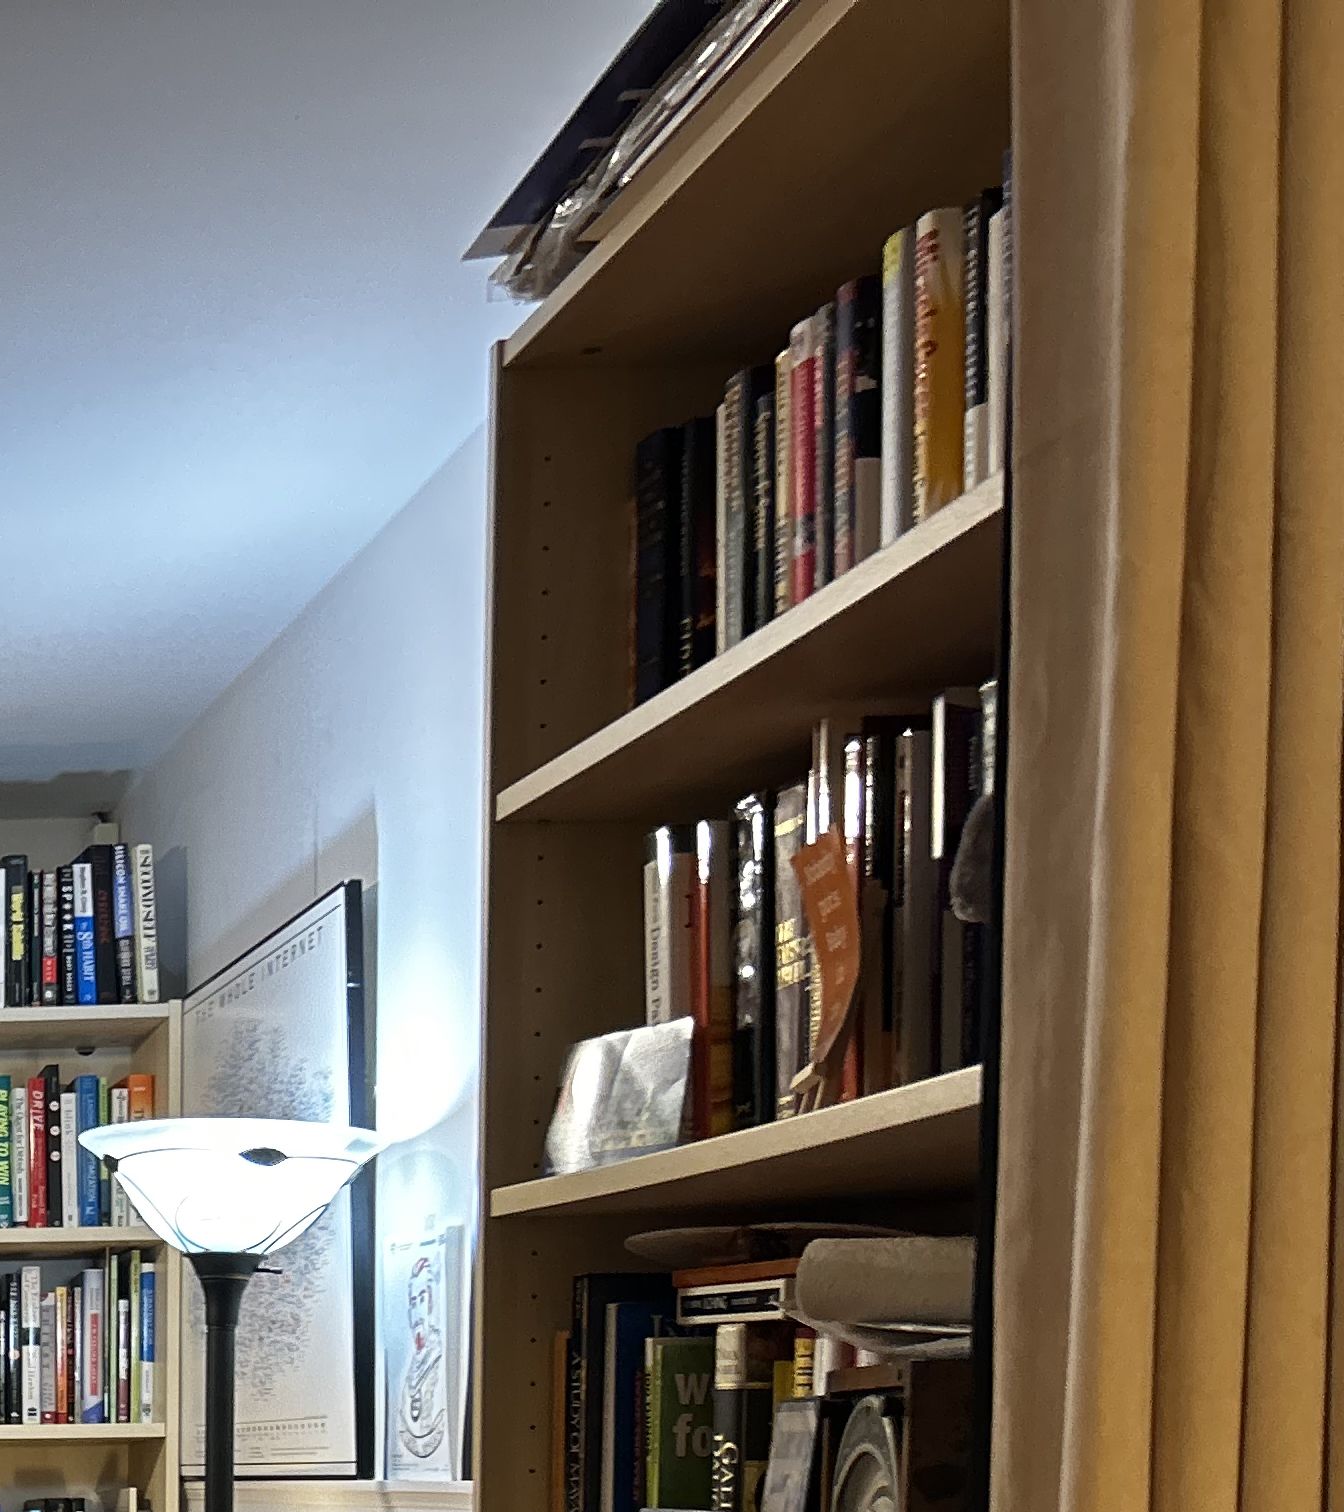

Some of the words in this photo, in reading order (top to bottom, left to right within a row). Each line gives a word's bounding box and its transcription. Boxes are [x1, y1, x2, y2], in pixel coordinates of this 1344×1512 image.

[77, 931, 91, 951] 8th
[261, 925, 323, 982] INTERNET
[80, 951, 95, 982] HABIT
[648, 927, 662, 992] Design
[32, 1091, 43, 1132] DRIVE
[64, 1109, 73, 1136] blink
[568, 1366, 581, 1420] STUDY
[568, 1433, 580, 1453] OF
